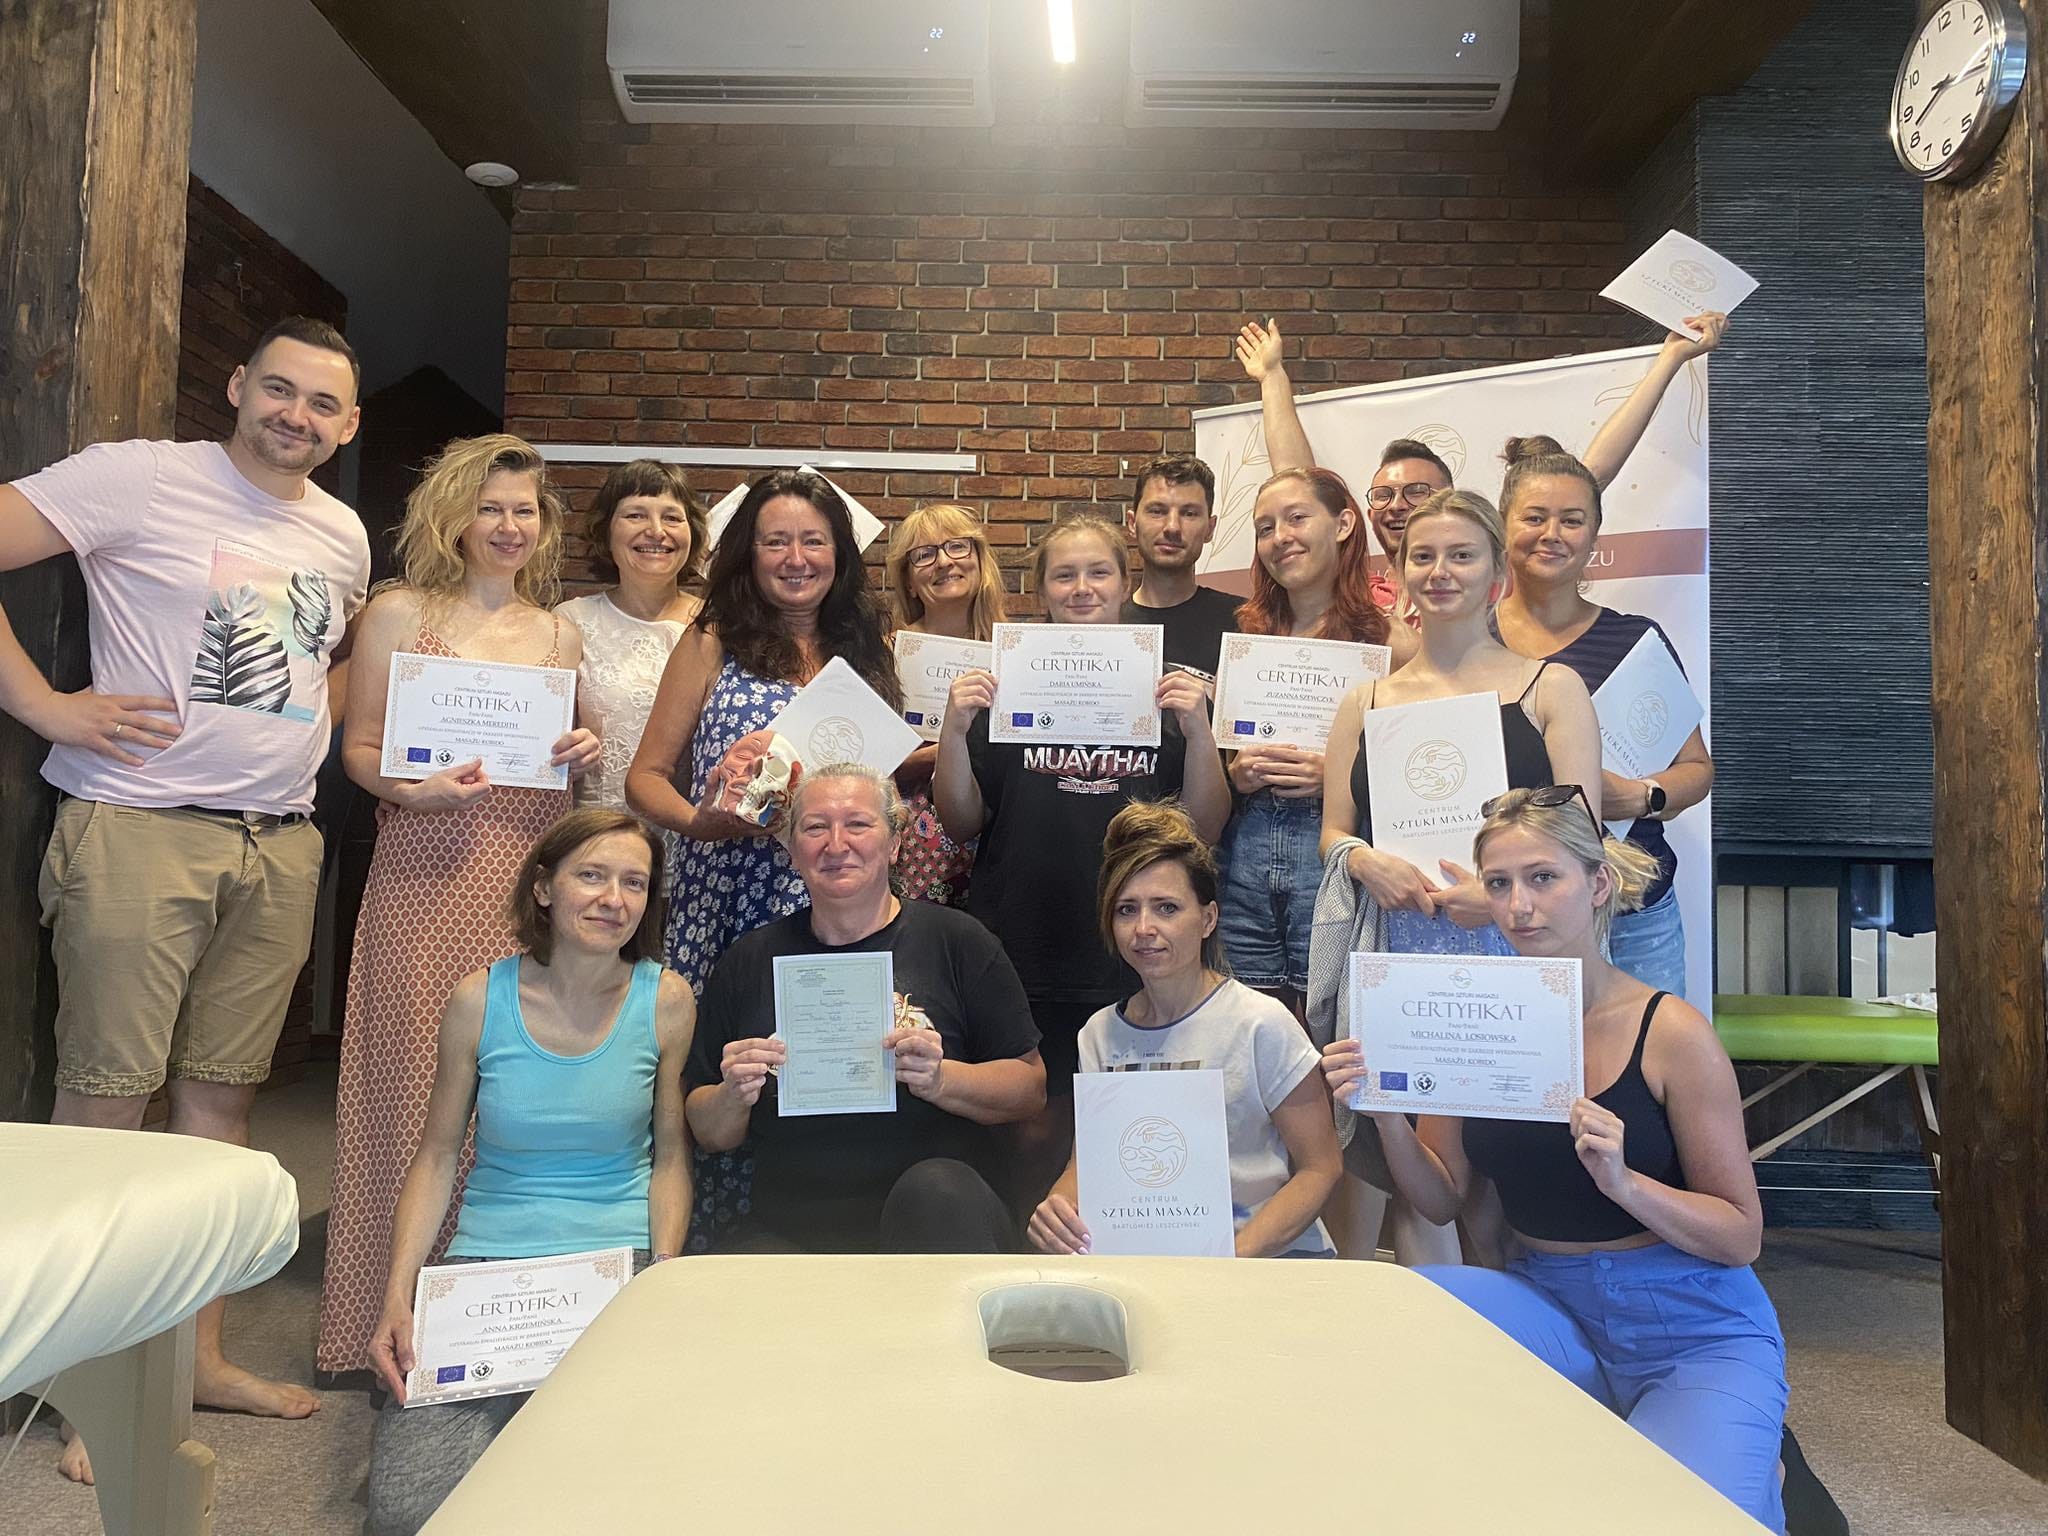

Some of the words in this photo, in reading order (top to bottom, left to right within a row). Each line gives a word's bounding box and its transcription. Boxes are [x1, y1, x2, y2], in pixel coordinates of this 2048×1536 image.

[1937, 10, 1951, 32] 12
[1973, 14, 1984, 35] 2
[930, 28, 943, 38] 22
[1461, 33, 1476, 43] 22
[1921, 39, 1930, 58] 11
[1909, 70, 1920, 90] 10
[1975, 78, 1986, 97] 4
[1903, 105, 1914, 123] 9
[1961, 113, 1973, 133] 5
[1910, 131, 1921, 149] 8
[1942, 138, 1953, 157] 6
[1924, 143, 1933, 161] 7
[1030, 658, 1124, 672] CERTYFIKAT
[1256, 669, 1349, 689] CERTYFIKAT
[431, 692, 533, 713] CERTYFIKAT
[441, 716, 480, 726] AGNIESZKA
[1418, 805, 1461, 815] CENTRUM
[1392, 816, 1436, 830] SZTUKI
[1401, 1000, 1528, 1021] CERTYFIKAT
[1410, 1030, 1461, 1041] MICHALINA
[1131, 1196, 1178, 1204] CENTRUM
[1101, 1207, 1150, 1218] SZTUKI
[465, 1291, 582, 1318] CERTYFIKAT
[491, 1292, 517, 1300] CENTRUM
[481, 1325, 507, 1335] ANNA
